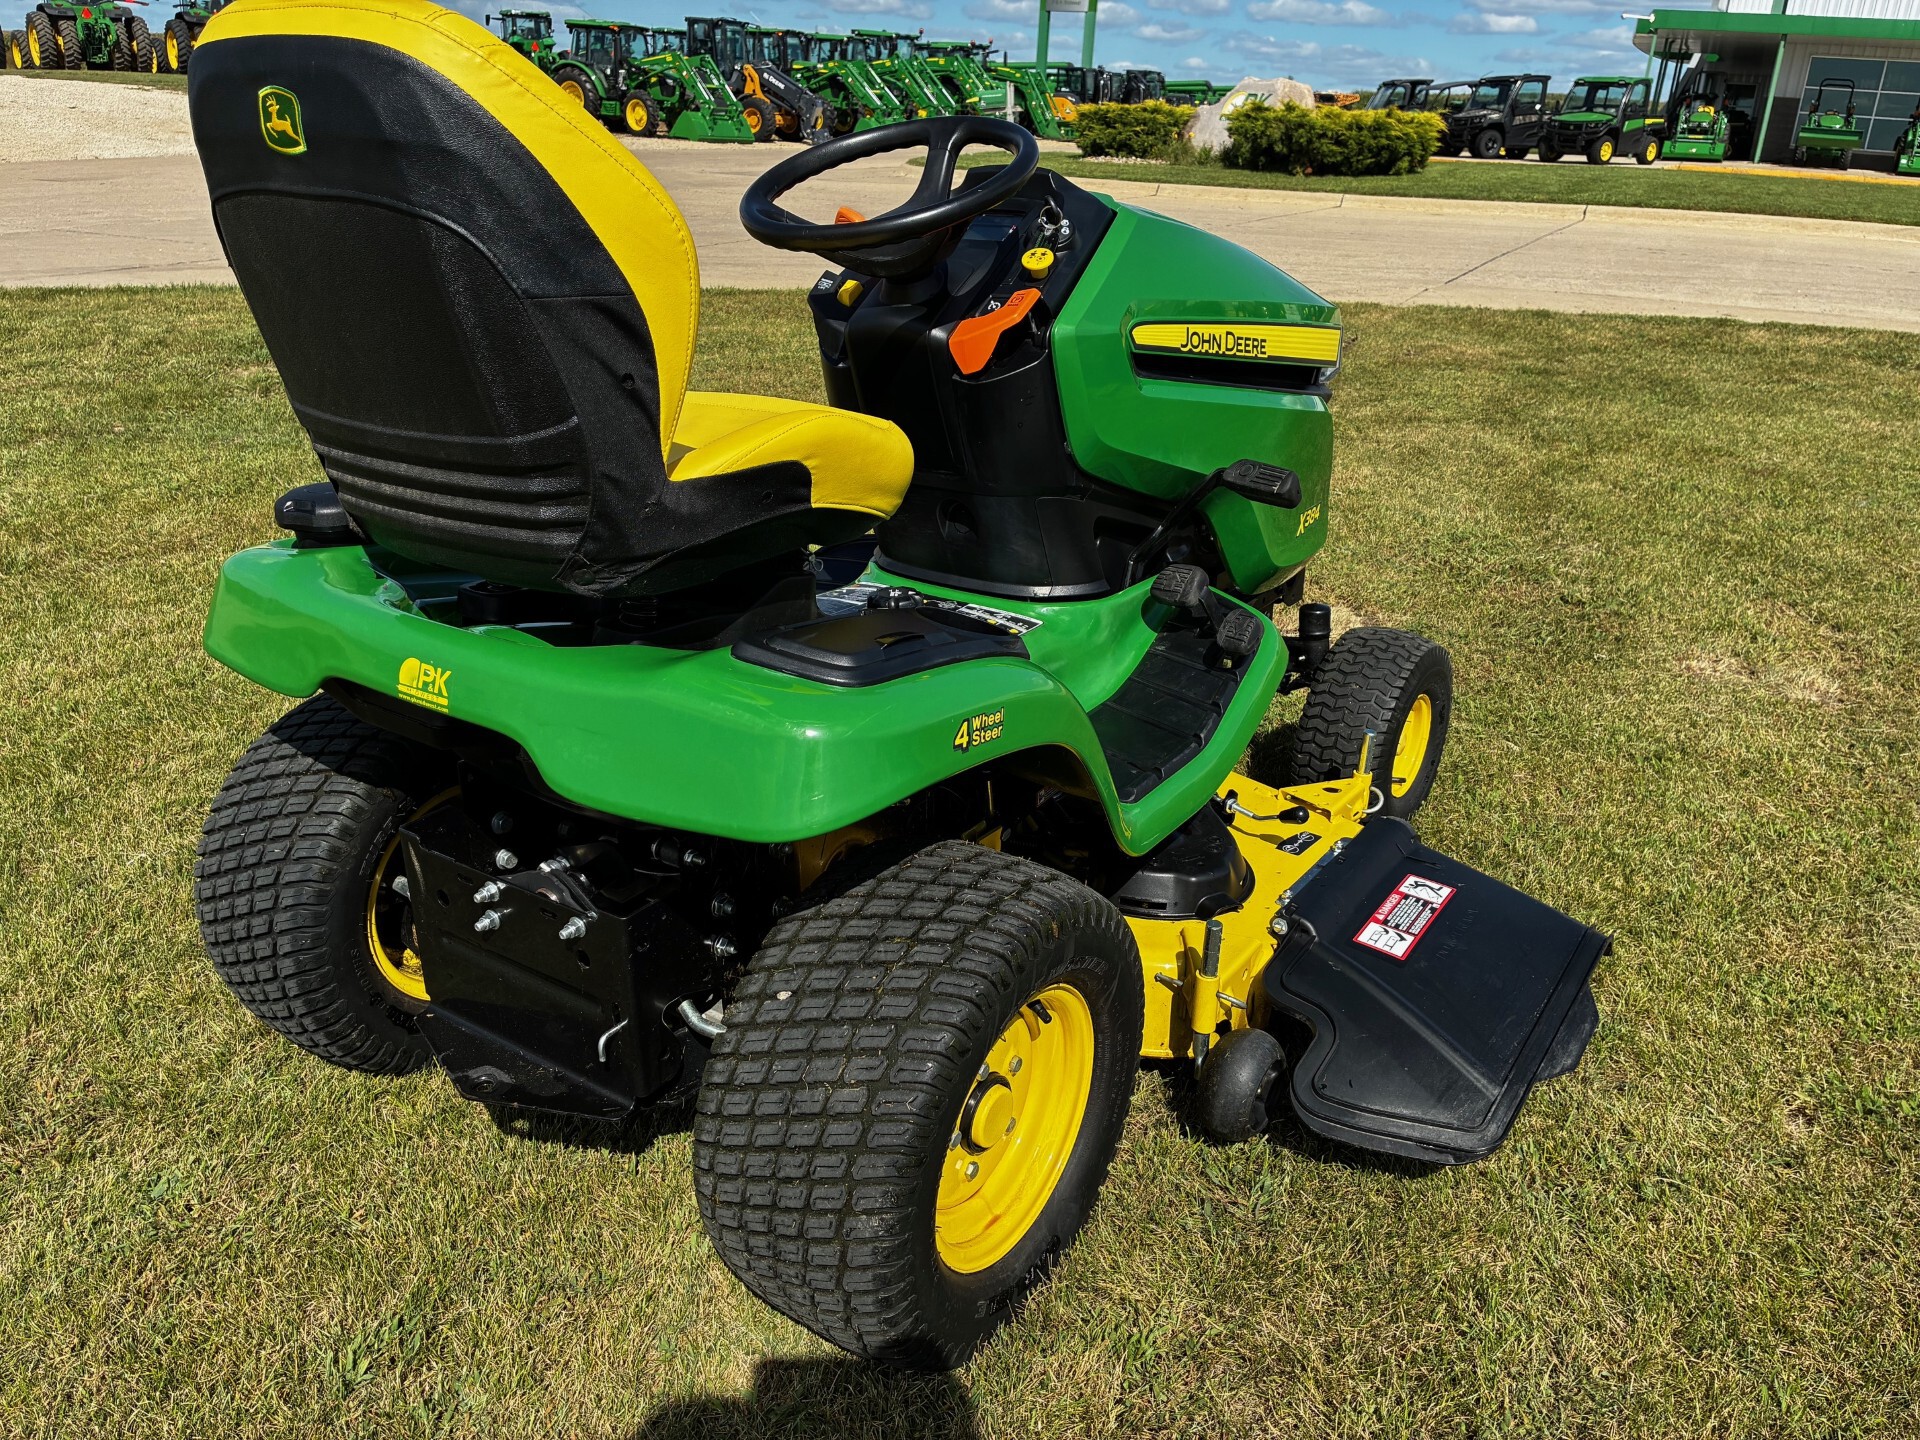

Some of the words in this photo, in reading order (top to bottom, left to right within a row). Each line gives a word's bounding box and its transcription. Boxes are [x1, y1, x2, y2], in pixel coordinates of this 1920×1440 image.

[1180, 326, 1222, 352] JOHN
[1225, 331, 1267, 356] DEERE
[1296, 503, 1321, 537] X384
[954, 720, 969, 749] 4
[972, 707, 1004, 731] Wheel
[972, 724, 1003, 746] Steer
[1379, 893, 1402, 915] DANGER
